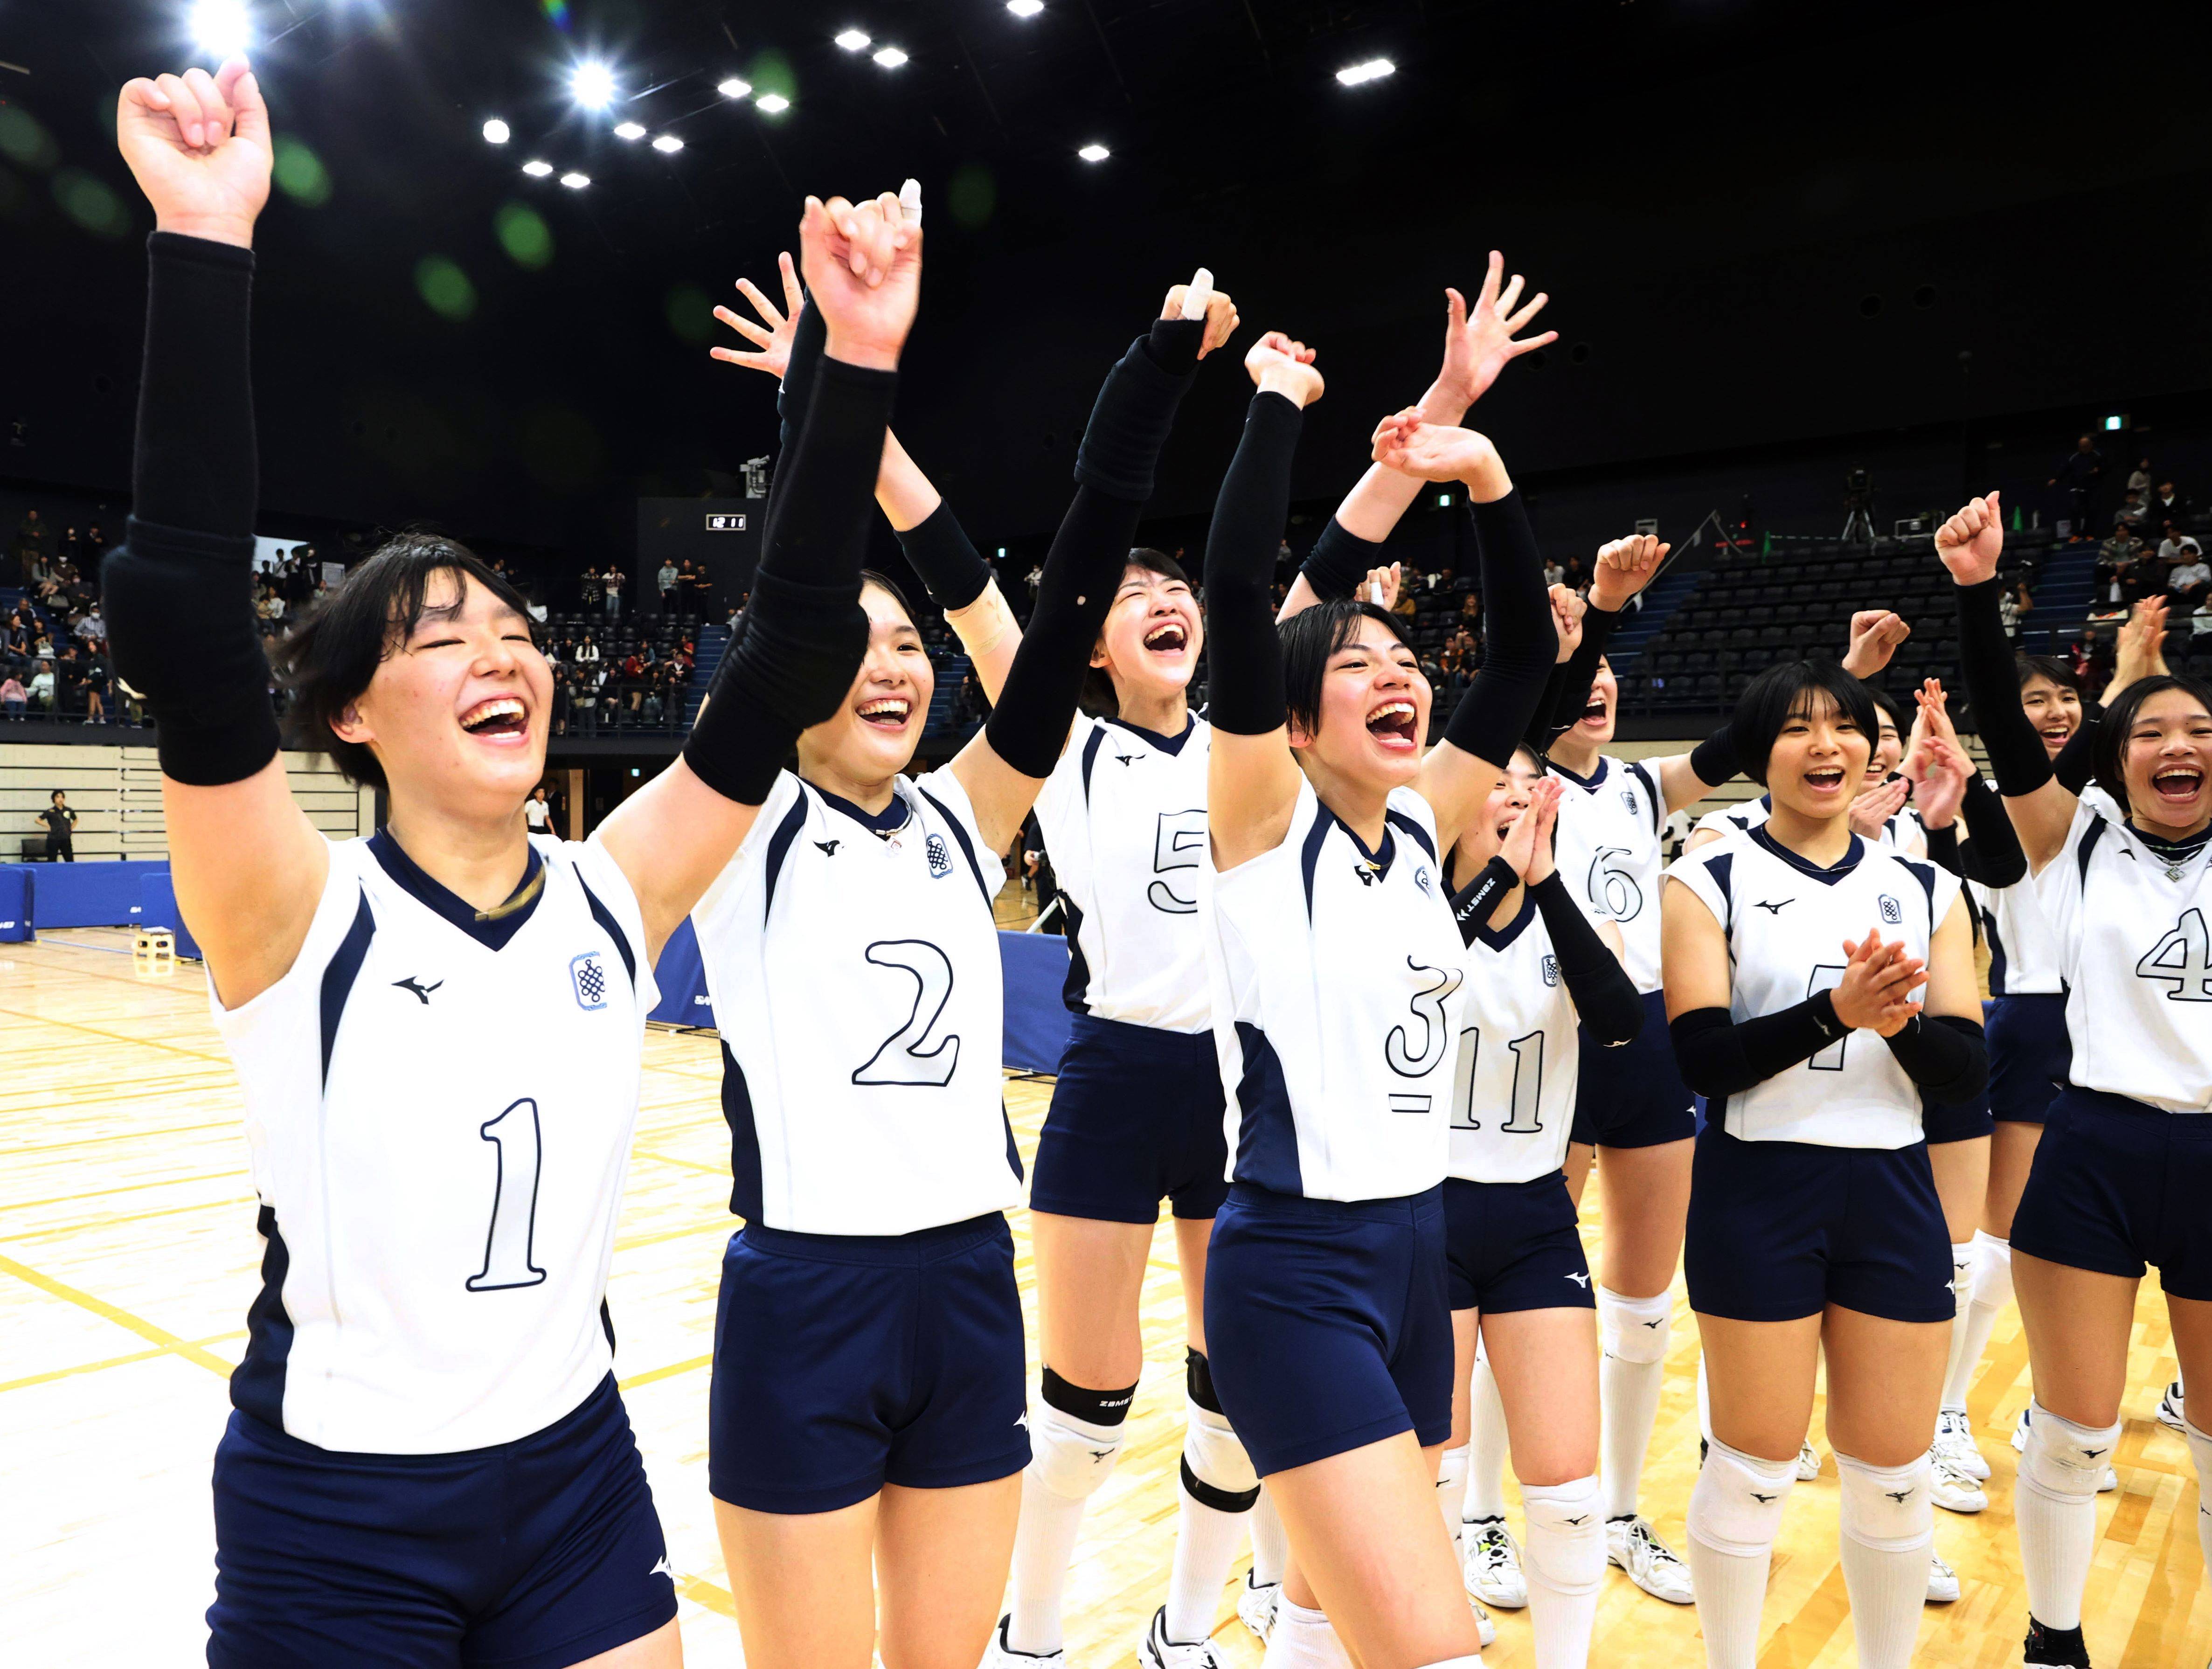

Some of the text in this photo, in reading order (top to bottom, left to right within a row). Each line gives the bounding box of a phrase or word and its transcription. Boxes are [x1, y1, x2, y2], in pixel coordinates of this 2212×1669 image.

[1147, 809, 1207, 914] 5
[1588, 845, 1643, 922] 6
[2136, 907, 2212, 1002] 4
[852, 939, 960, 1087] 2
[1385, 954, 1463, 1078] 3
[1450, 1026, 1544, 1134] 11
[465, 1098, 547, 1292] 1
